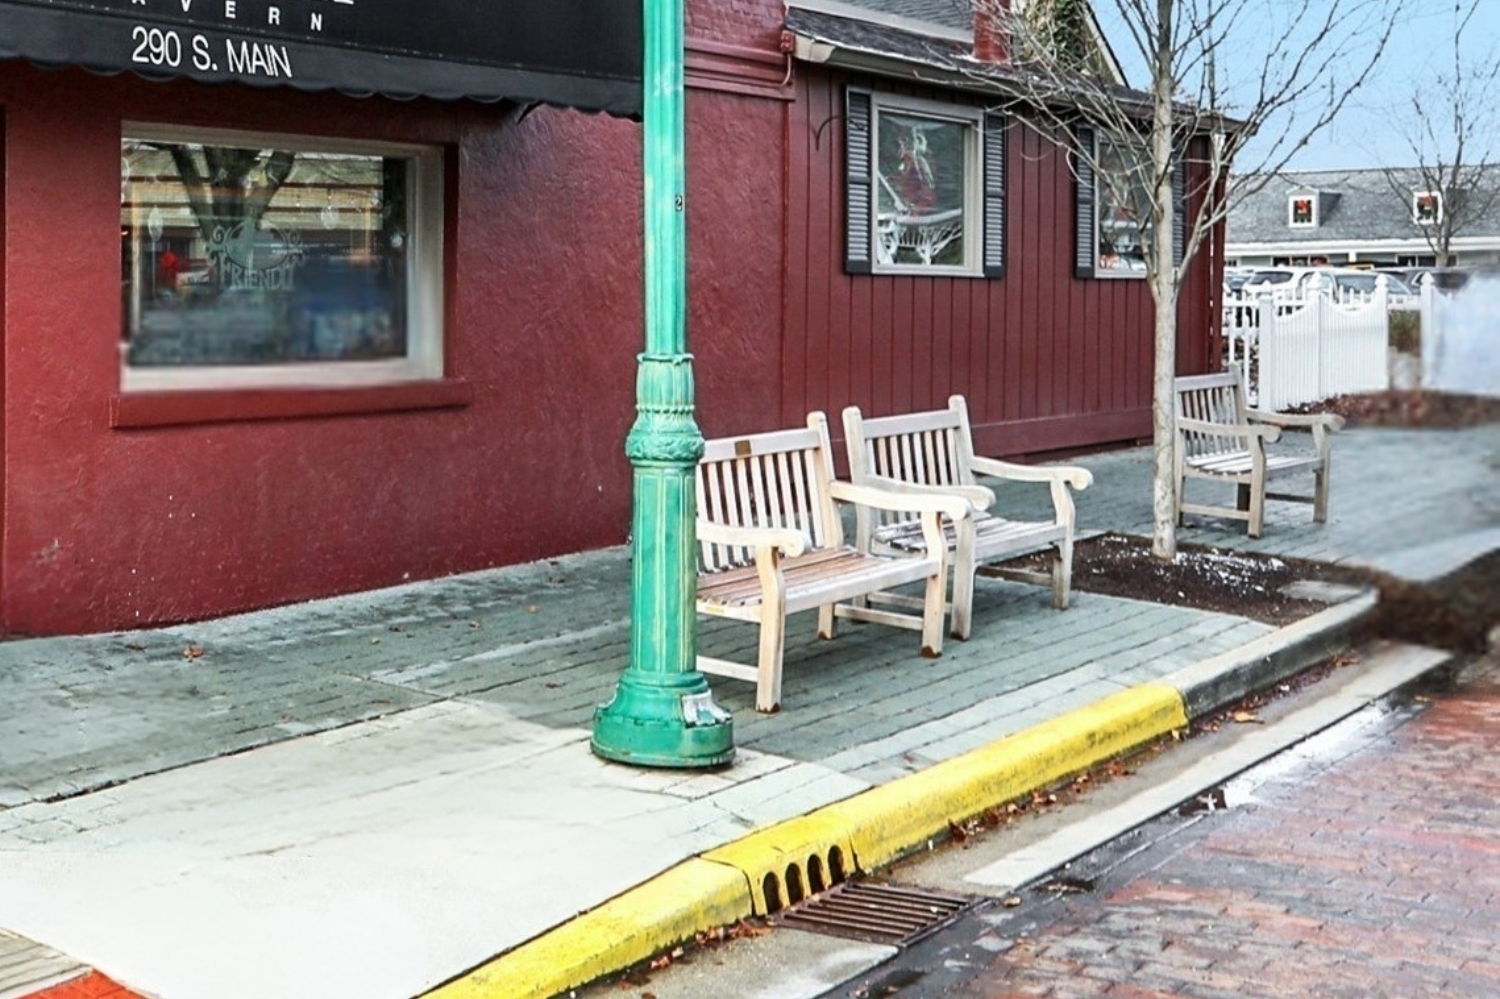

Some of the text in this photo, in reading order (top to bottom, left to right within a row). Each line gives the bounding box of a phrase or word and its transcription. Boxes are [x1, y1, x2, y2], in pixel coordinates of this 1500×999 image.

[132, 26, 293, 78] 290 S. MAIN
